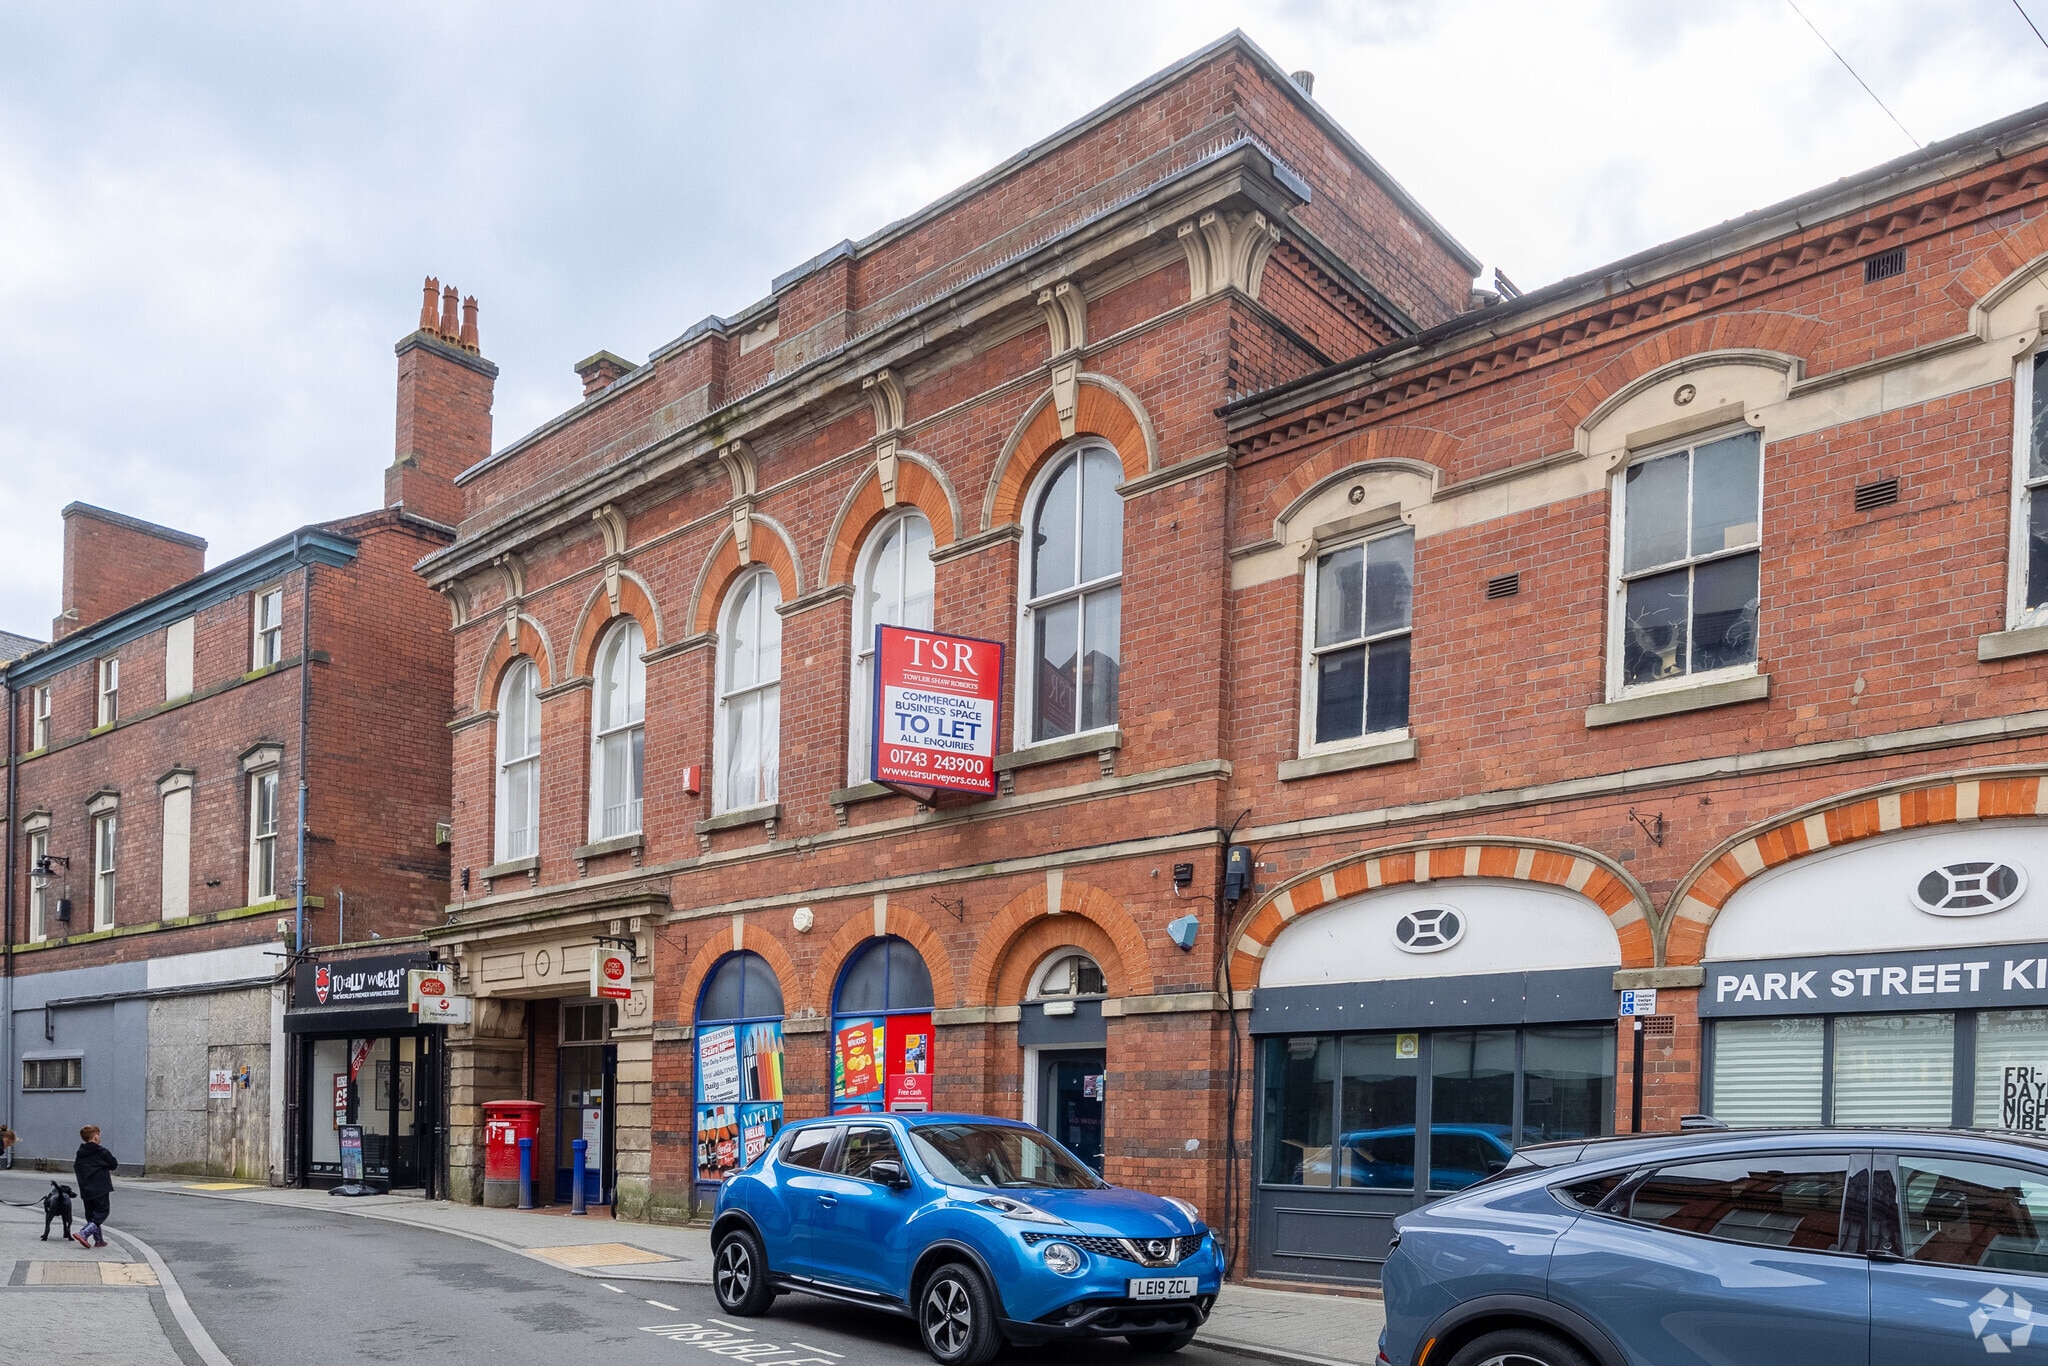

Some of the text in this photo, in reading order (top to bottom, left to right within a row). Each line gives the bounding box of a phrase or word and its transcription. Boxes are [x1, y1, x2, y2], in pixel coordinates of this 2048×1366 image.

[904, 635, 979, 676] TSR
[903, 673, 979, 690] TOWLER SHAW ROBERTS
[902, 691, 977, 710] COMMERCIAL/
[895, 701, 982, 721] BUSINESS SPACE
[894, 711, 982, 741] TO LET
[900, 734, 975, 751] ALL ENQUIRIES
[890, 748, 984, 775] 01743 243900
[882, 765, 991, 788] www.tsrsurveyors.co.uk
[604, 967, 623, 976] OFFICE
[607, 961, 621, 969] POST
[421, 986, 443, 994] OFFICE
[1716, 970, 1818, 1002] PARK
[1830, 961, 1990, 998] STREET
[715, 1028, 734, 1040] EXPRESS
[847, 1035, 867, 1048] WALKERS
[702, 1045, 718, 1057] Sun
[704, 1075, 739, 1091] Daily Mail
[745, 1125, 765, 1138] HELLO!
[746, 1141, 762, 1155] OK!
[1137, 1279, 1191, 1296] LE19 ZCL
